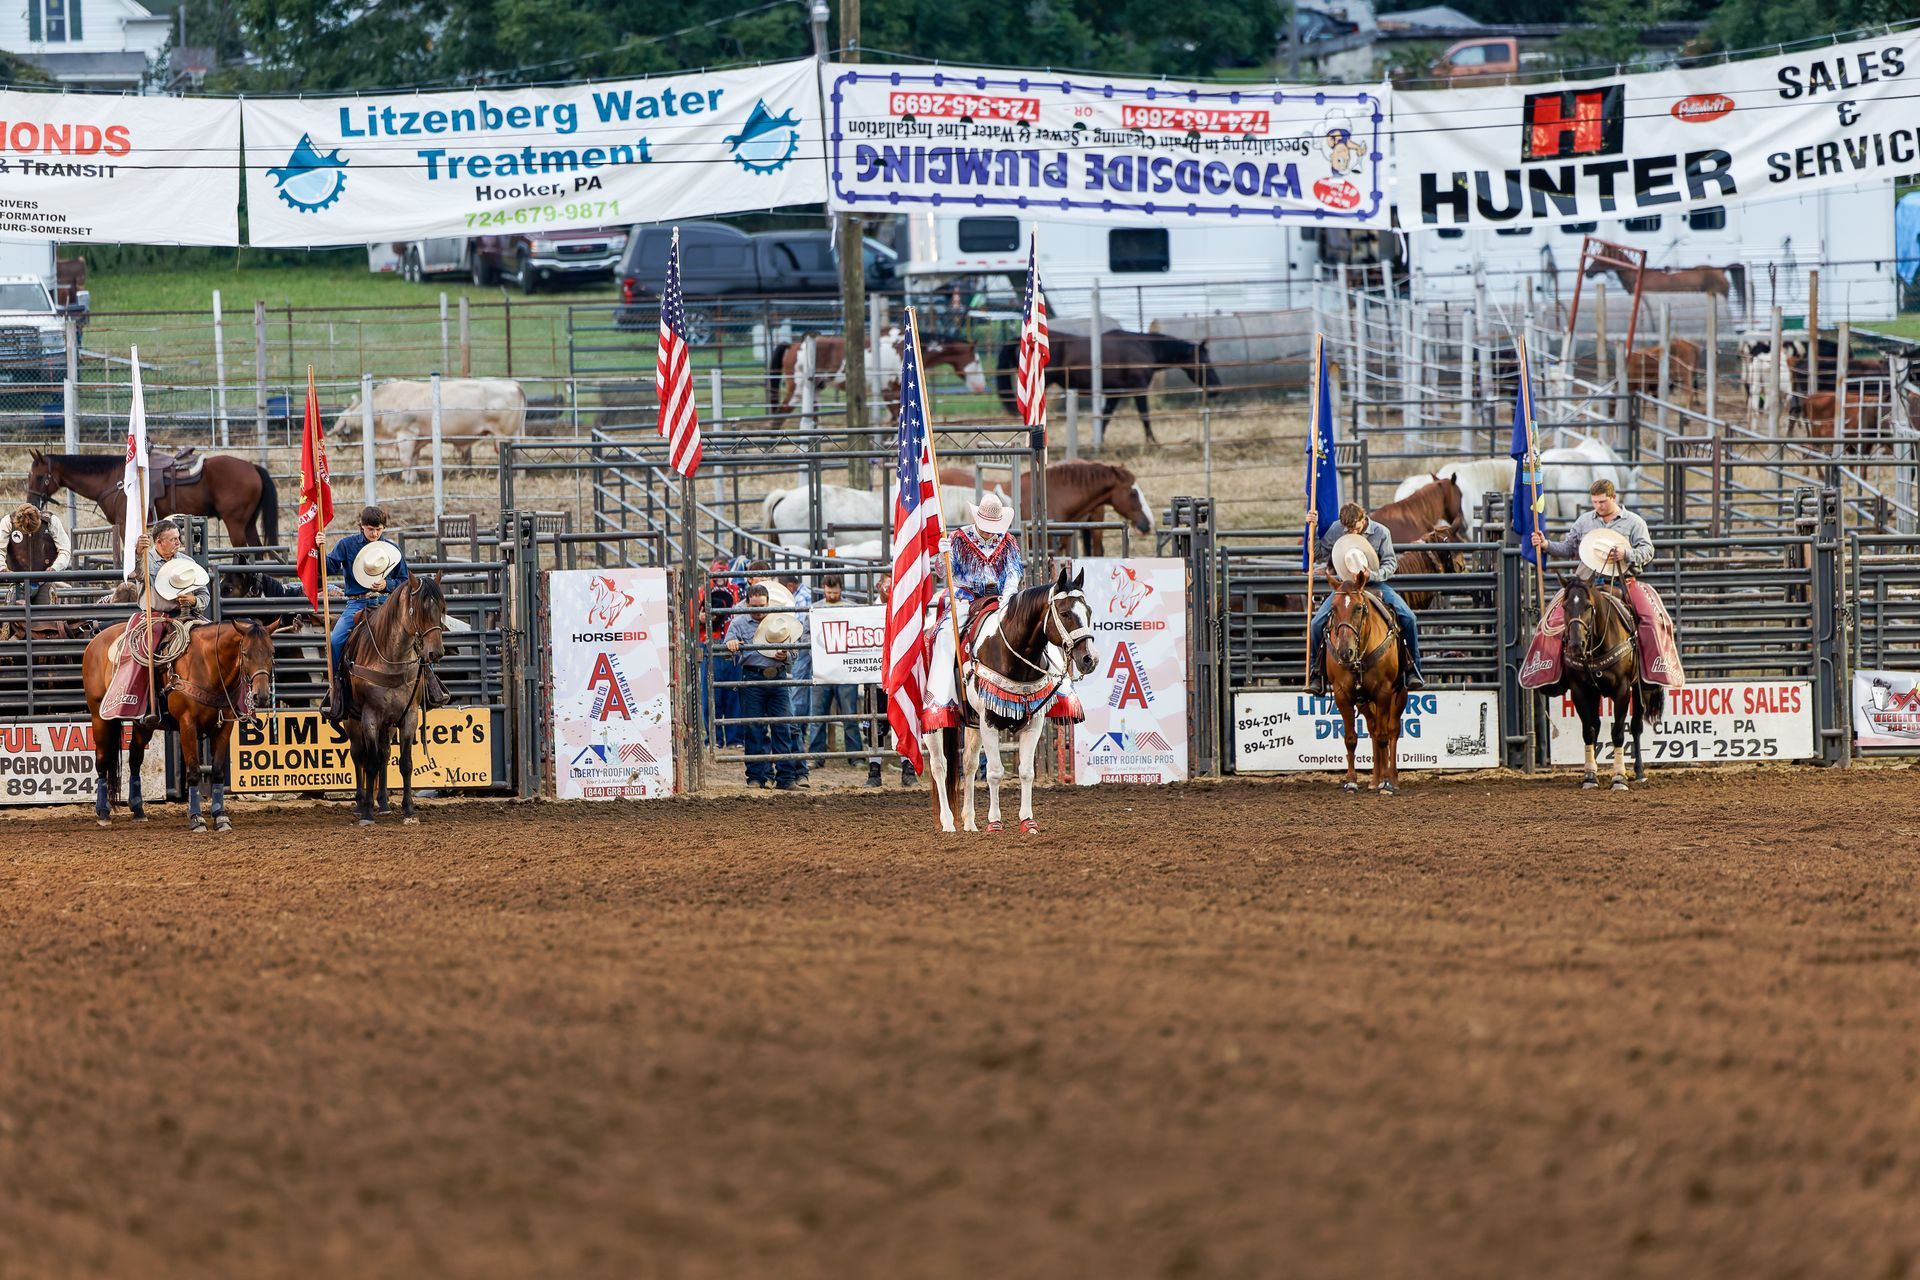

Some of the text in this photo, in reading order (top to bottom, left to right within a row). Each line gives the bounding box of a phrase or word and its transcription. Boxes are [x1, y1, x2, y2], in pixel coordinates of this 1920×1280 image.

[1778, 47, 1905, 99] SALES
[339, 88, 724, 137] Litzenberg Water
[892, 93, 1036, 120] 724-545-2699
[1124, 107, 1267, 132] 724-763-2661
[1837, 100, 1862, 127] &
[848, 120, 933, 140] Installation
[936, 122, 968, 140] Line
[972, 124, 1015, 143] Water
[1036, 128, 1080, 146] Sewer
[1531, 91, 1603, 157] H
[0, 121, 132, 157] ONDS
[1223, 137, 1310, 156] Specializing
[417, 136, 653, 181] Treatment
[855, 145, 1068, 188] PLUMBING
[1767, 128, 1920, 184] SERVIC
[475, 176, 603, 202] Hooker, PA
[1085, 153, 1303, 200] WOODSIDE
[1420, 149, 1738, 223] HUNTER
[465, 199, 621, 229] 724-679-9871
[572, 630, 648, 643] HORSEBID
[822, 620, 886, 655] Watso
[1093, 620, 1166, 631] HORSEBID
[1668, 685, 1801, 716] TRUCK SALES
[239, 715, 350, 746] BIM'S
[1238, 712, 1291, 731] 894-2074
[1262, 727, 1274, 738] or
[1653, 719, 1756, 736] CLAIRE, PA
[1244, 735, 1294, 754] 894-2776
[239, 749, 351, 770] BOLONEY
[413, 757, 438, 777] and
[1088, 754, 1174, 765] LIBERTY ROOFING PROS
[1298, 754, 1343, 764] Complete
[1402, 753, 1438, 764] Drilling
[239, 767, 488, 787] & DEER PROCESSING More
